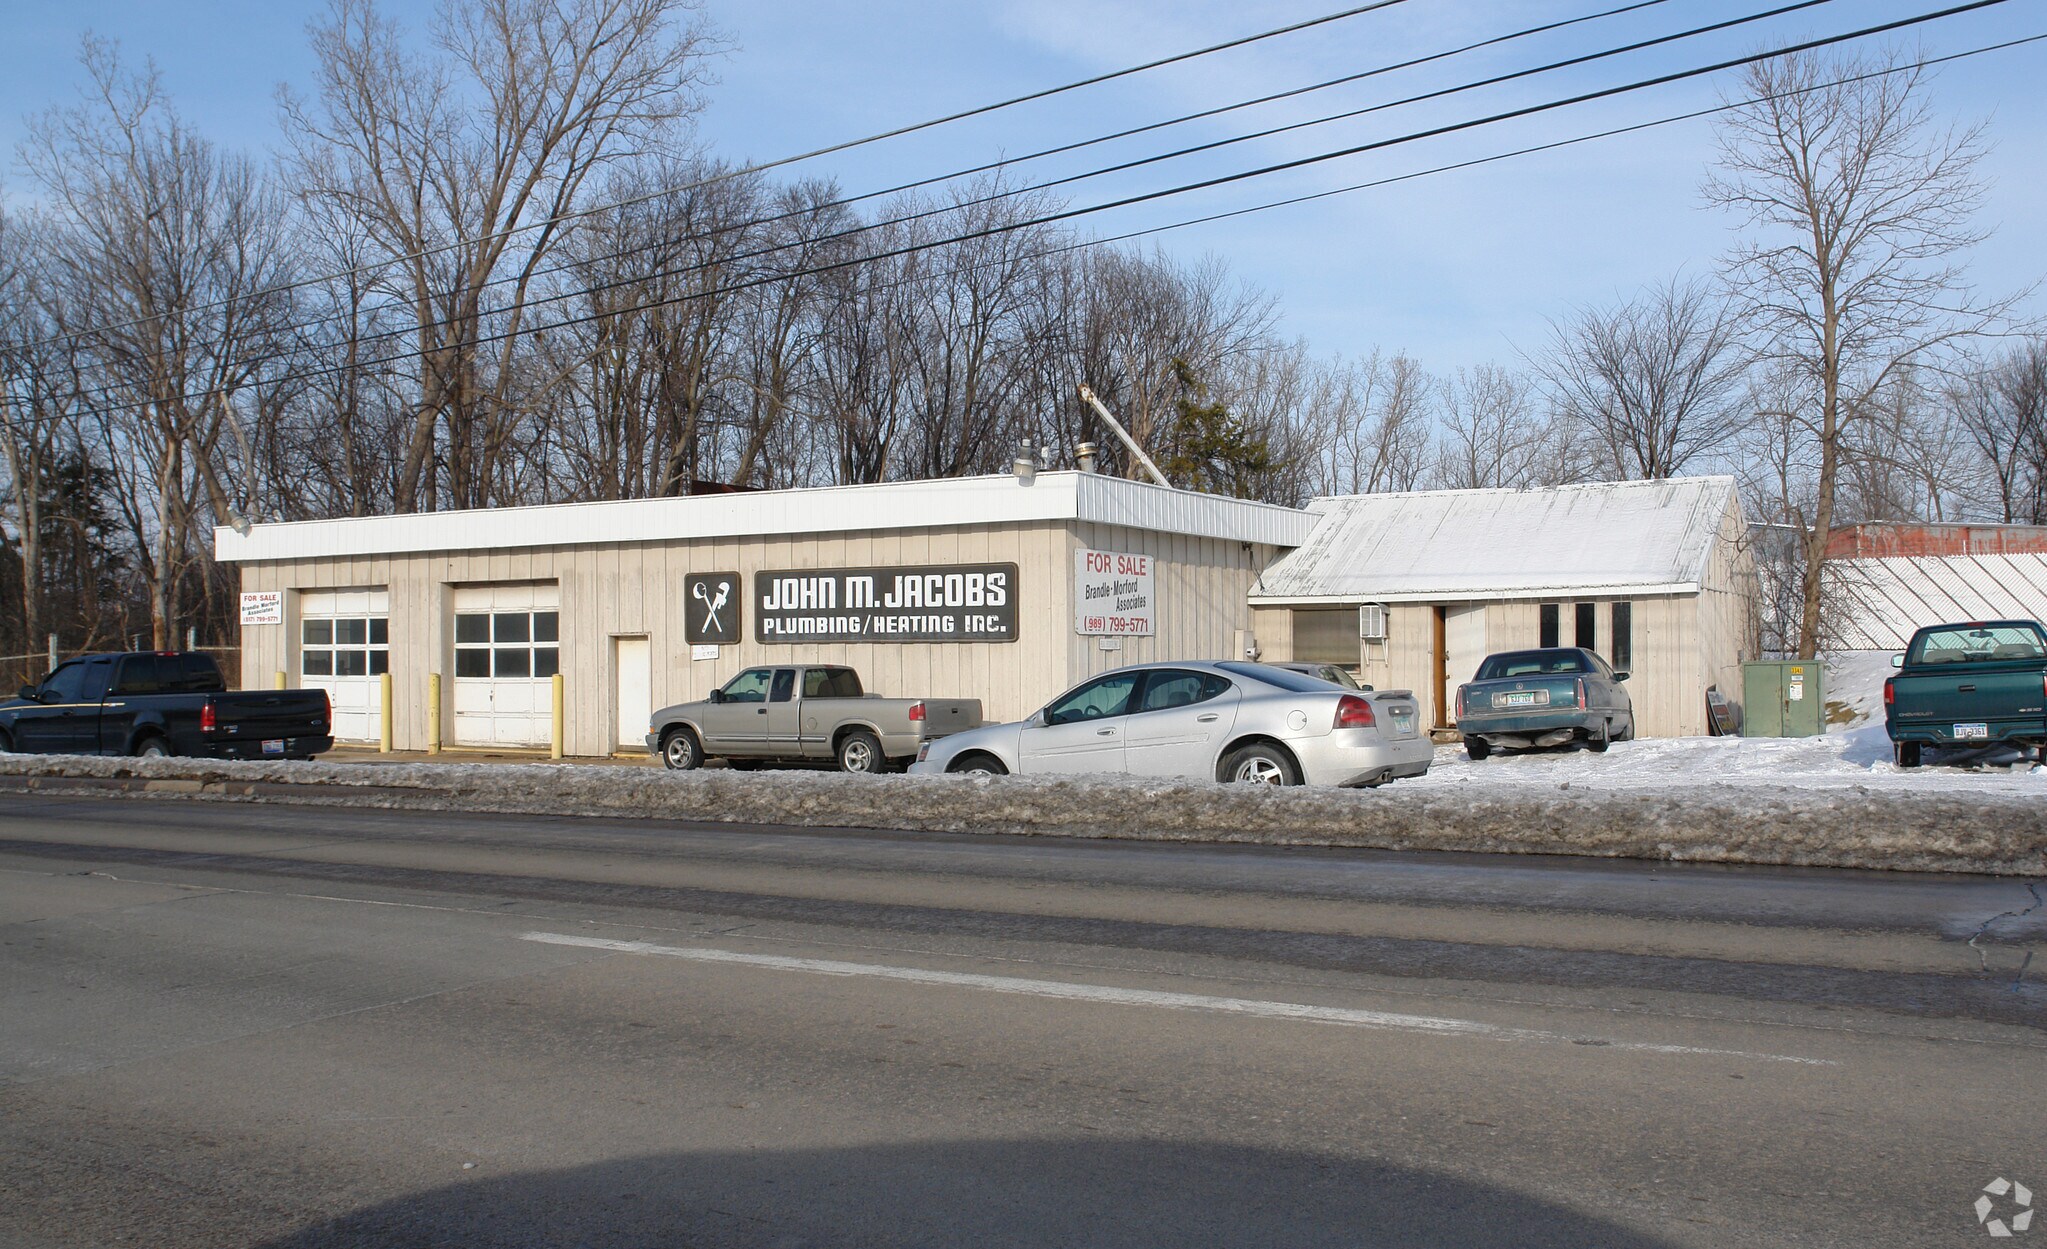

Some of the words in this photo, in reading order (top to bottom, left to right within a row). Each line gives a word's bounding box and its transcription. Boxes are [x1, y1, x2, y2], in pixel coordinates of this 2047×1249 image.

[1086, 553, 1112, 573] FOR
[1117, 555, 1147, 576] SALE
[763, 577, 836, 610] JOHN
[845, 575, 881, 609] M.
[884, 572, 1006, 608] JACOBS
[1116, 594, 1147, 612] Associates
[965, 614, 1007, 633] INC.
[1084, 615, 1106, 632] (989)
[1109, 616, 1148, 633] 799-5771
